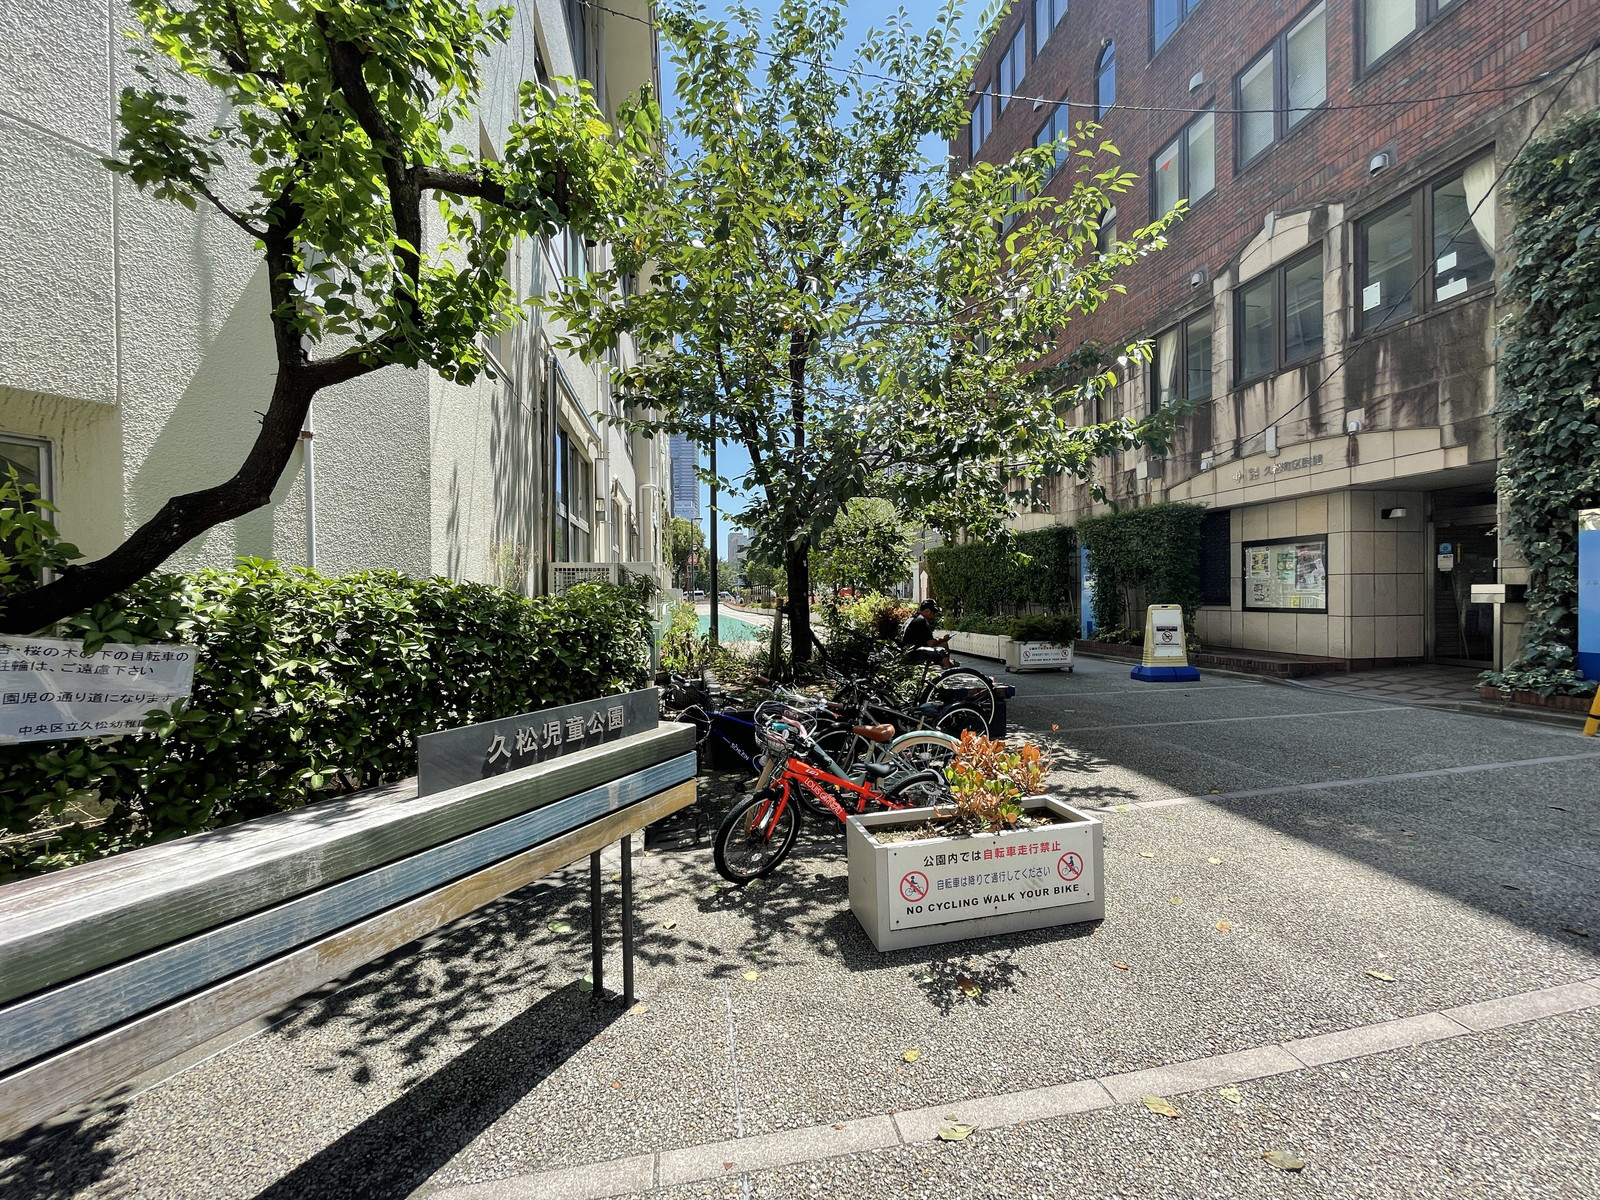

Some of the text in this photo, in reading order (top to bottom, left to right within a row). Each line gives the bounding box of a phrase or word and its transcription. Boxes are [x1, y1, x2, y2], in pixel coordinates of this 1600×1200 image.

[487, 705, 625, 764] 久松児童公園
[804, 777, 822, 795] LOUIS
[936, 866, 1050, 890] 自転車は降りて通行してください
[906, 884, 1080, 915] NO CYCLING WALK YOUR BIKE
